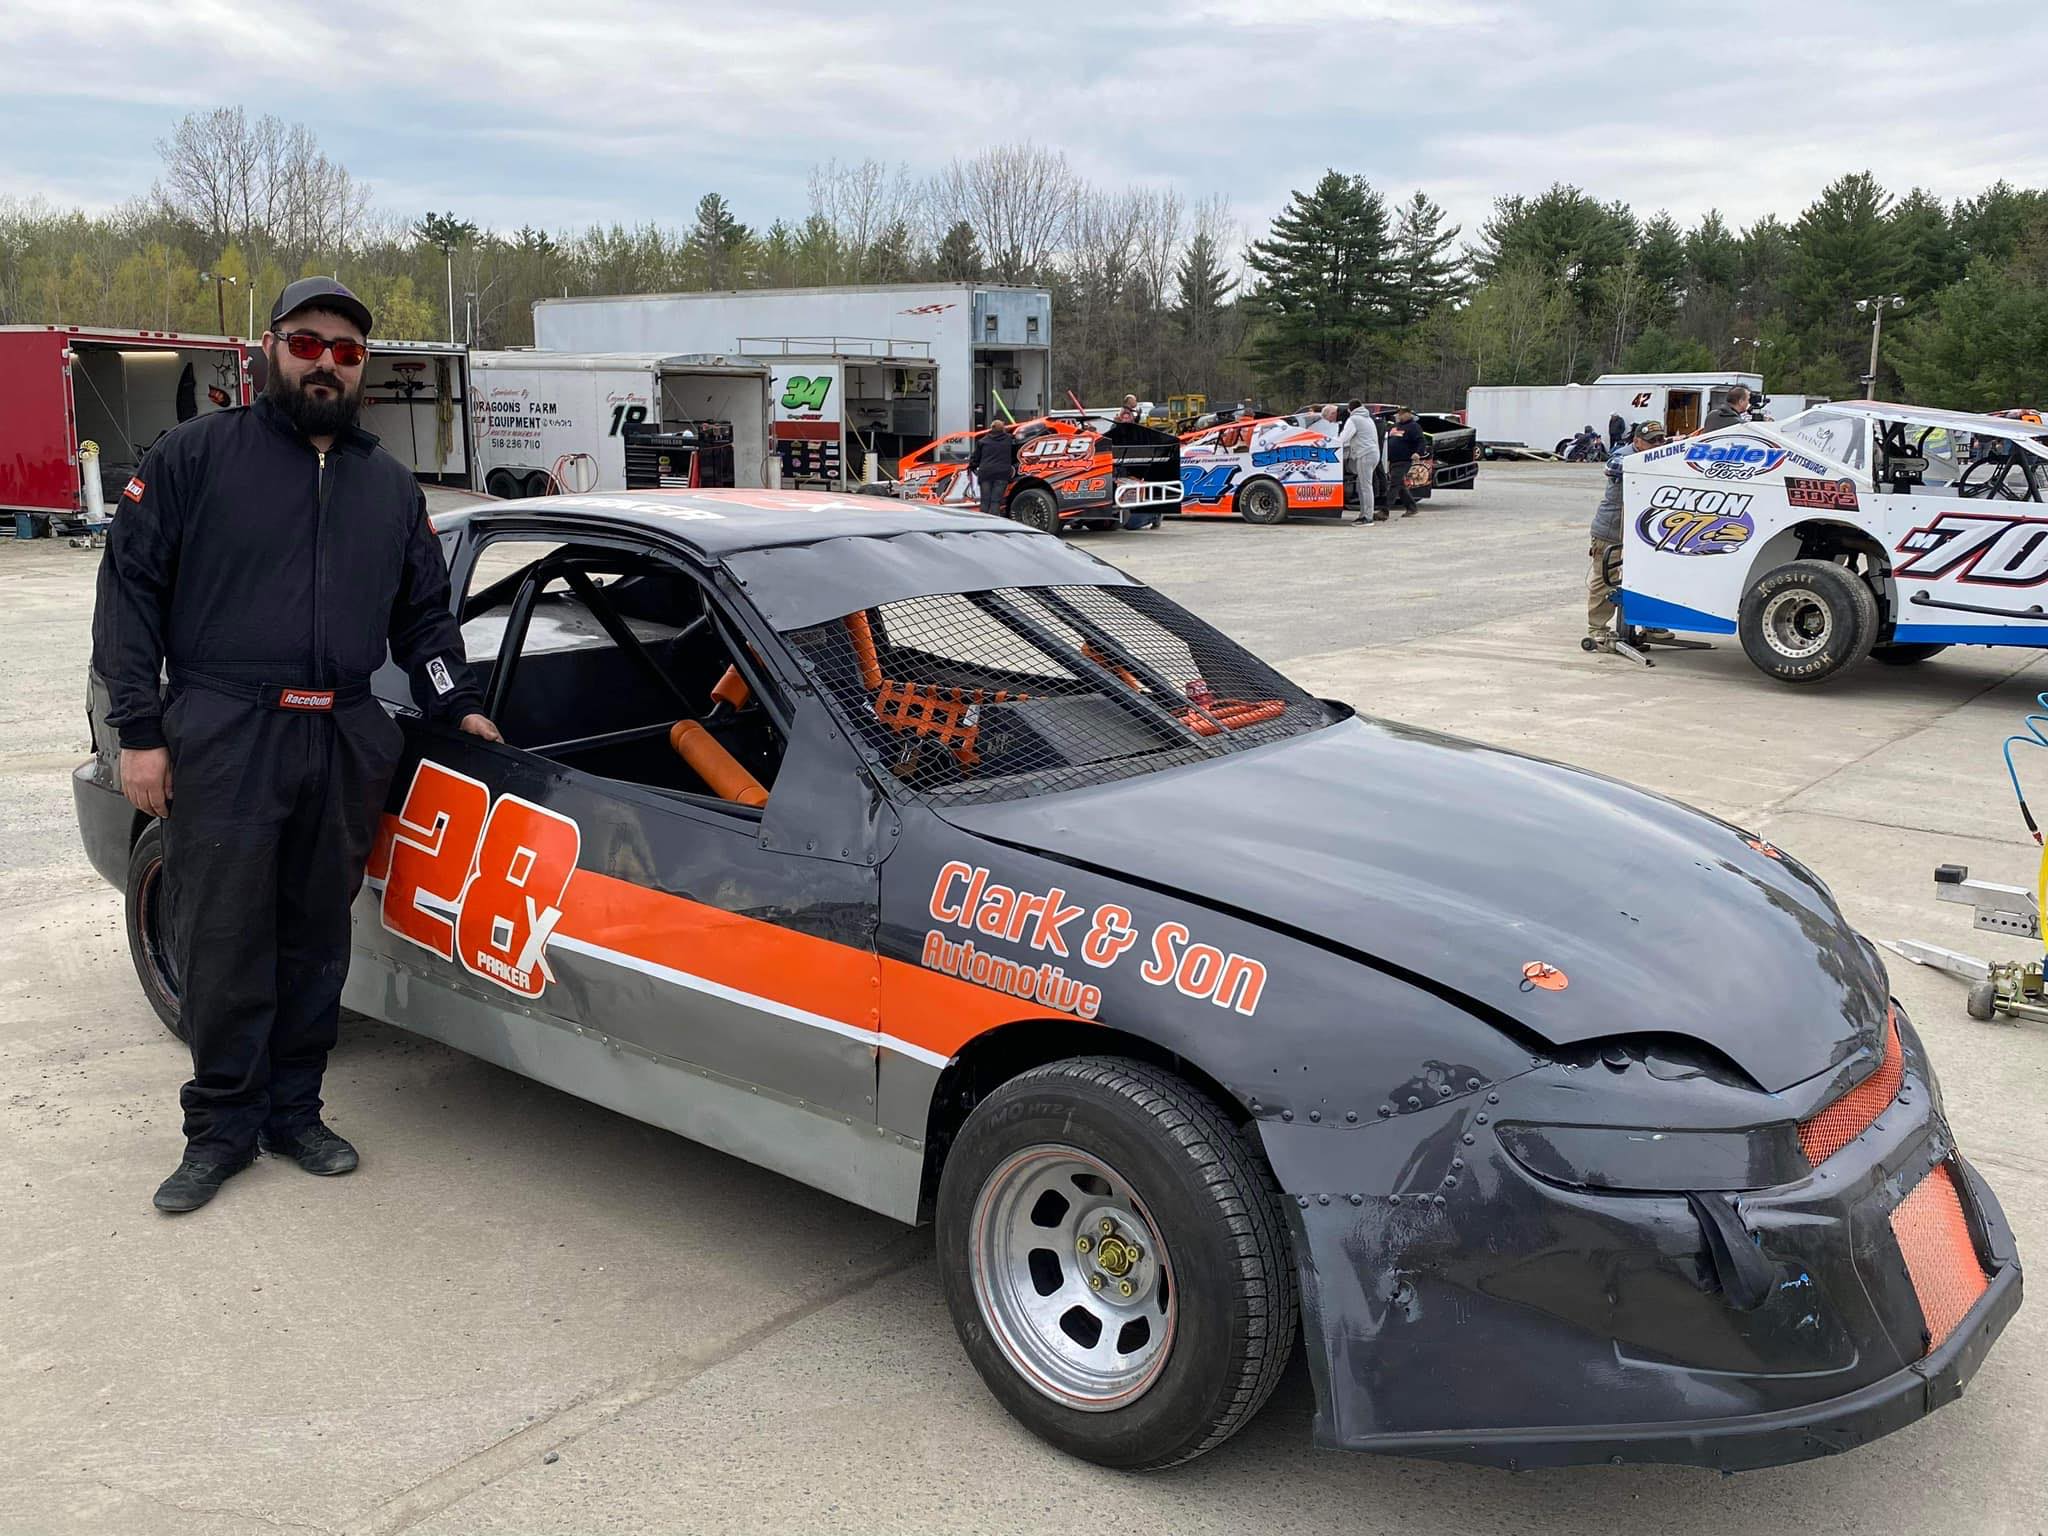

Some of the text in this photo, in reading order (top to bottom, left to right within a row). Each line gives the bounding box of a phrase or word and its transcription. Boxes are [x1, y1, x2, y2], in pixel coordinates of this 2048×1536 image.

[781, 375, 833, 410] 34
[1631, 392, 1652, 408] 42
[529, 402, 557, 414] FARM
[488, 416, 541, 429] EQUIPMENT
[1021, 436, 1093, 457] JDS
[1252, 446, 1339, 467] SHOCK
[1644, 442, 1828, 476] MALONE Bailey PLATTSBURGH
[1704, 461, 1755, 480] Ford
[1795, 478, 1840, 491] BIG
[1650, 485, 1754, 517] CKON
[1789, 489, 1857, 507] BOYS
[1656, 511, 1750, 553] 97.3
[929, 860, 1267, 1016] Clark & Son
[477, 950, 531, 990] PARKER
[921, 929, 1101, 1019] Automotive
